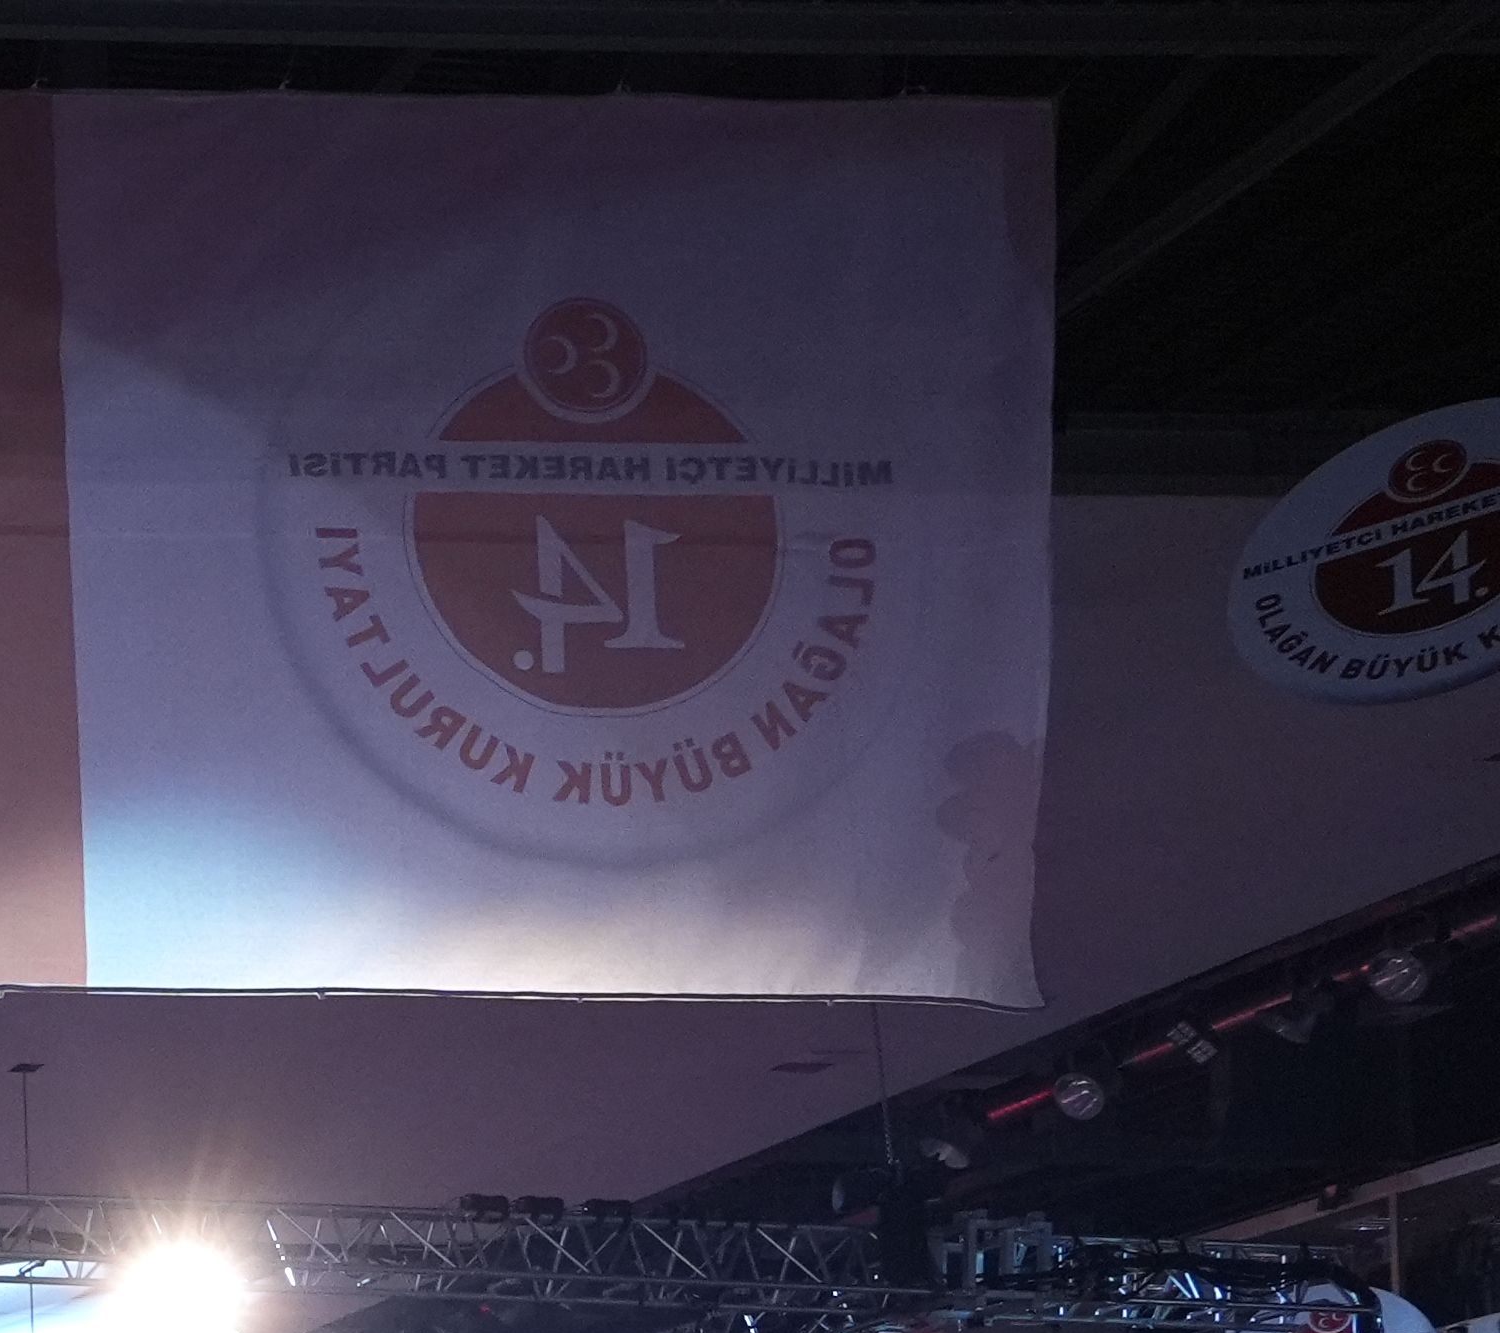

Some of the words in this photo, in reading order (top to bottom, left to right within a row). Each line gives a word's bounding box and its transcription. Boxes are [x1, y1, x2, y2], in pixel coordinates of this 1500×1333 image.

[1391, 492, 1500, 535] HAREKE
[1255, 593, 1339, 675] OLAĞAN
[1339, 641, 1468, 681] BÜYÜK
